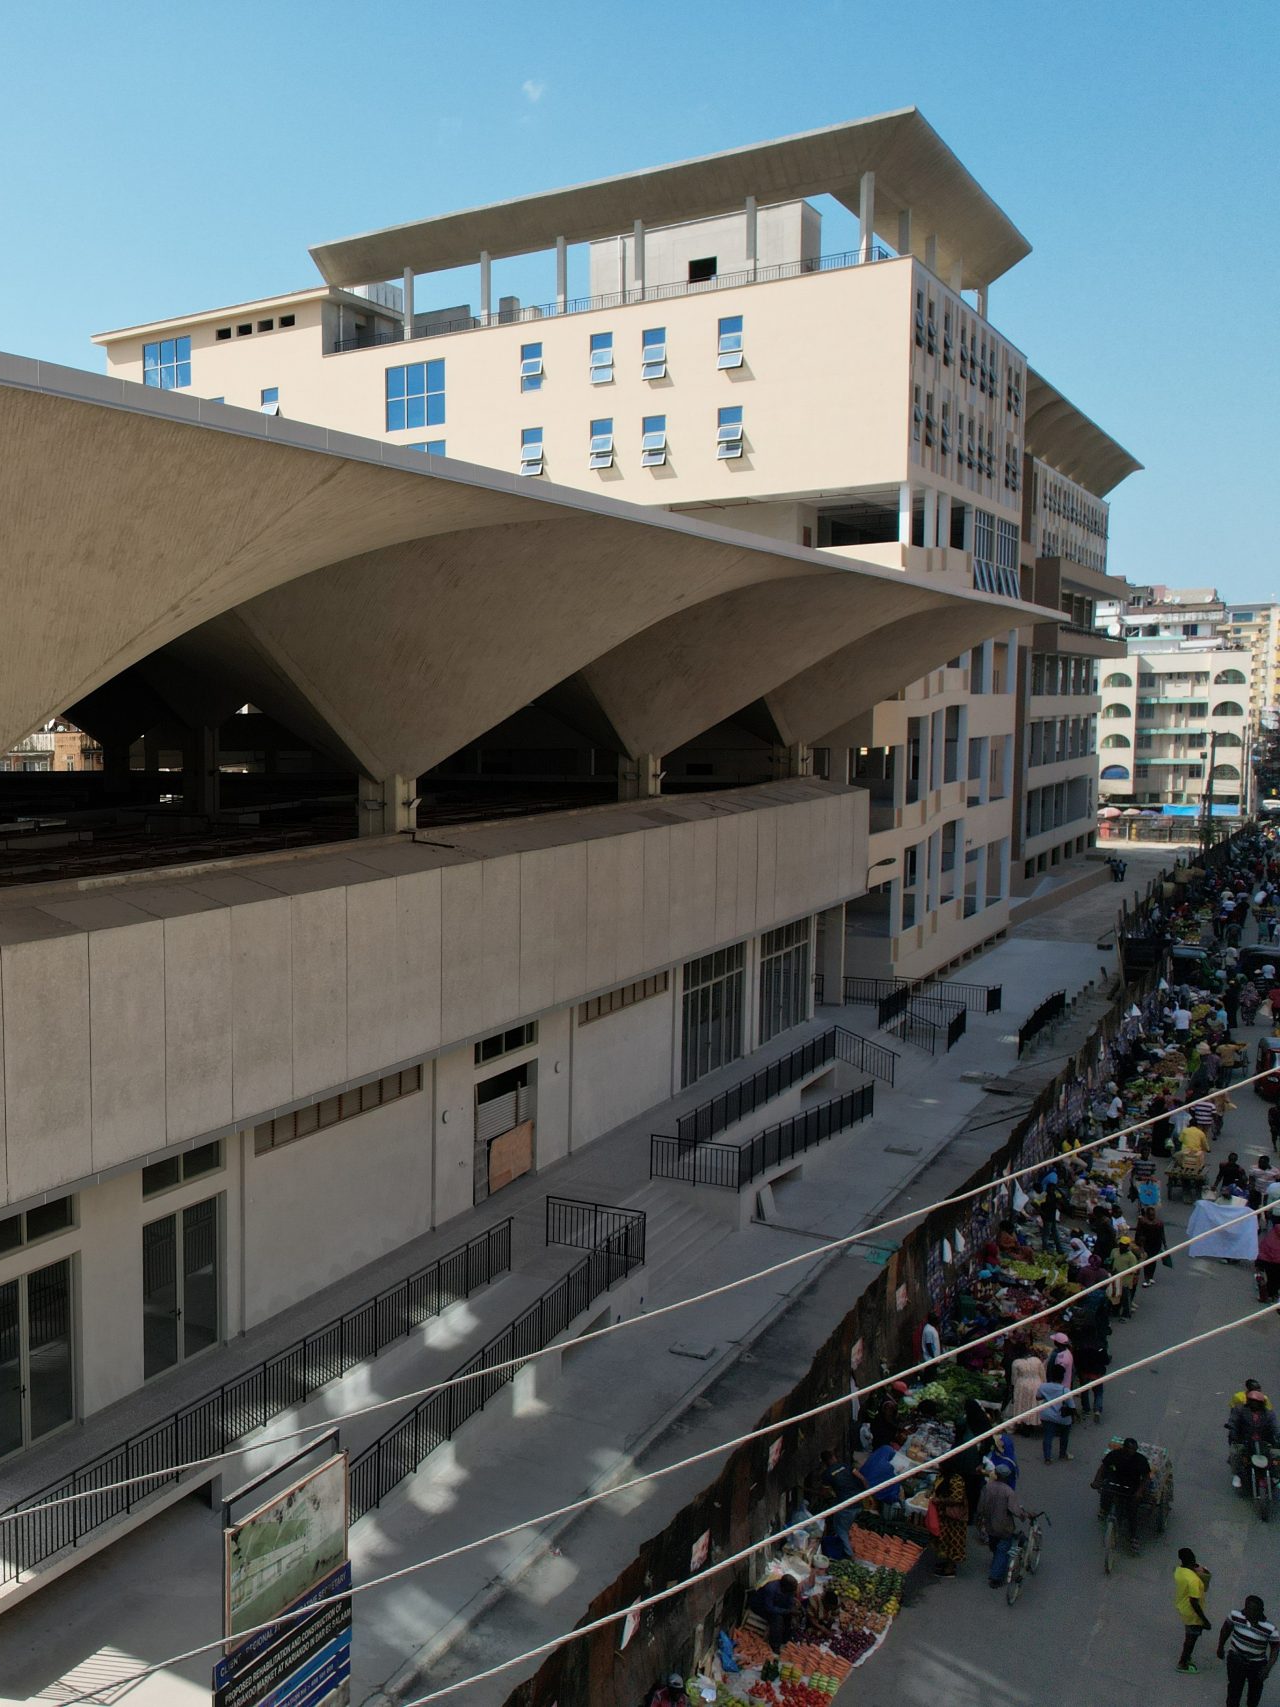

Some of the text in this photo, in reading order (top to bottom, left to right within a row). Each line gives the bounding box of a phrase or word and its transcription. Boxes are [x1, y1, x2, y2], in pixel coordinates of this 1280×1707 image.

[225, 1676, 252, 1705] PROPOSED
[252, 1643, 291, 1683] REHABILITATION
[291, 1636, 301, 1651] AND
[301, 1608, 336, 1641] CONSTRUCTION
[335, 1601, 343, 1613] OF
[256, 1670, 278, 1690] MARKET
[278, 1663, 286, 1676] AT
[284, 1645, 310, 1670] KARIAKOO
[309, 1640, 316, 1650] IN
[315, 1631, 325, 1644] DAR
[325, 1625, 332, 1635] ES
[332, 1607, 351, 1629] SALAAM
